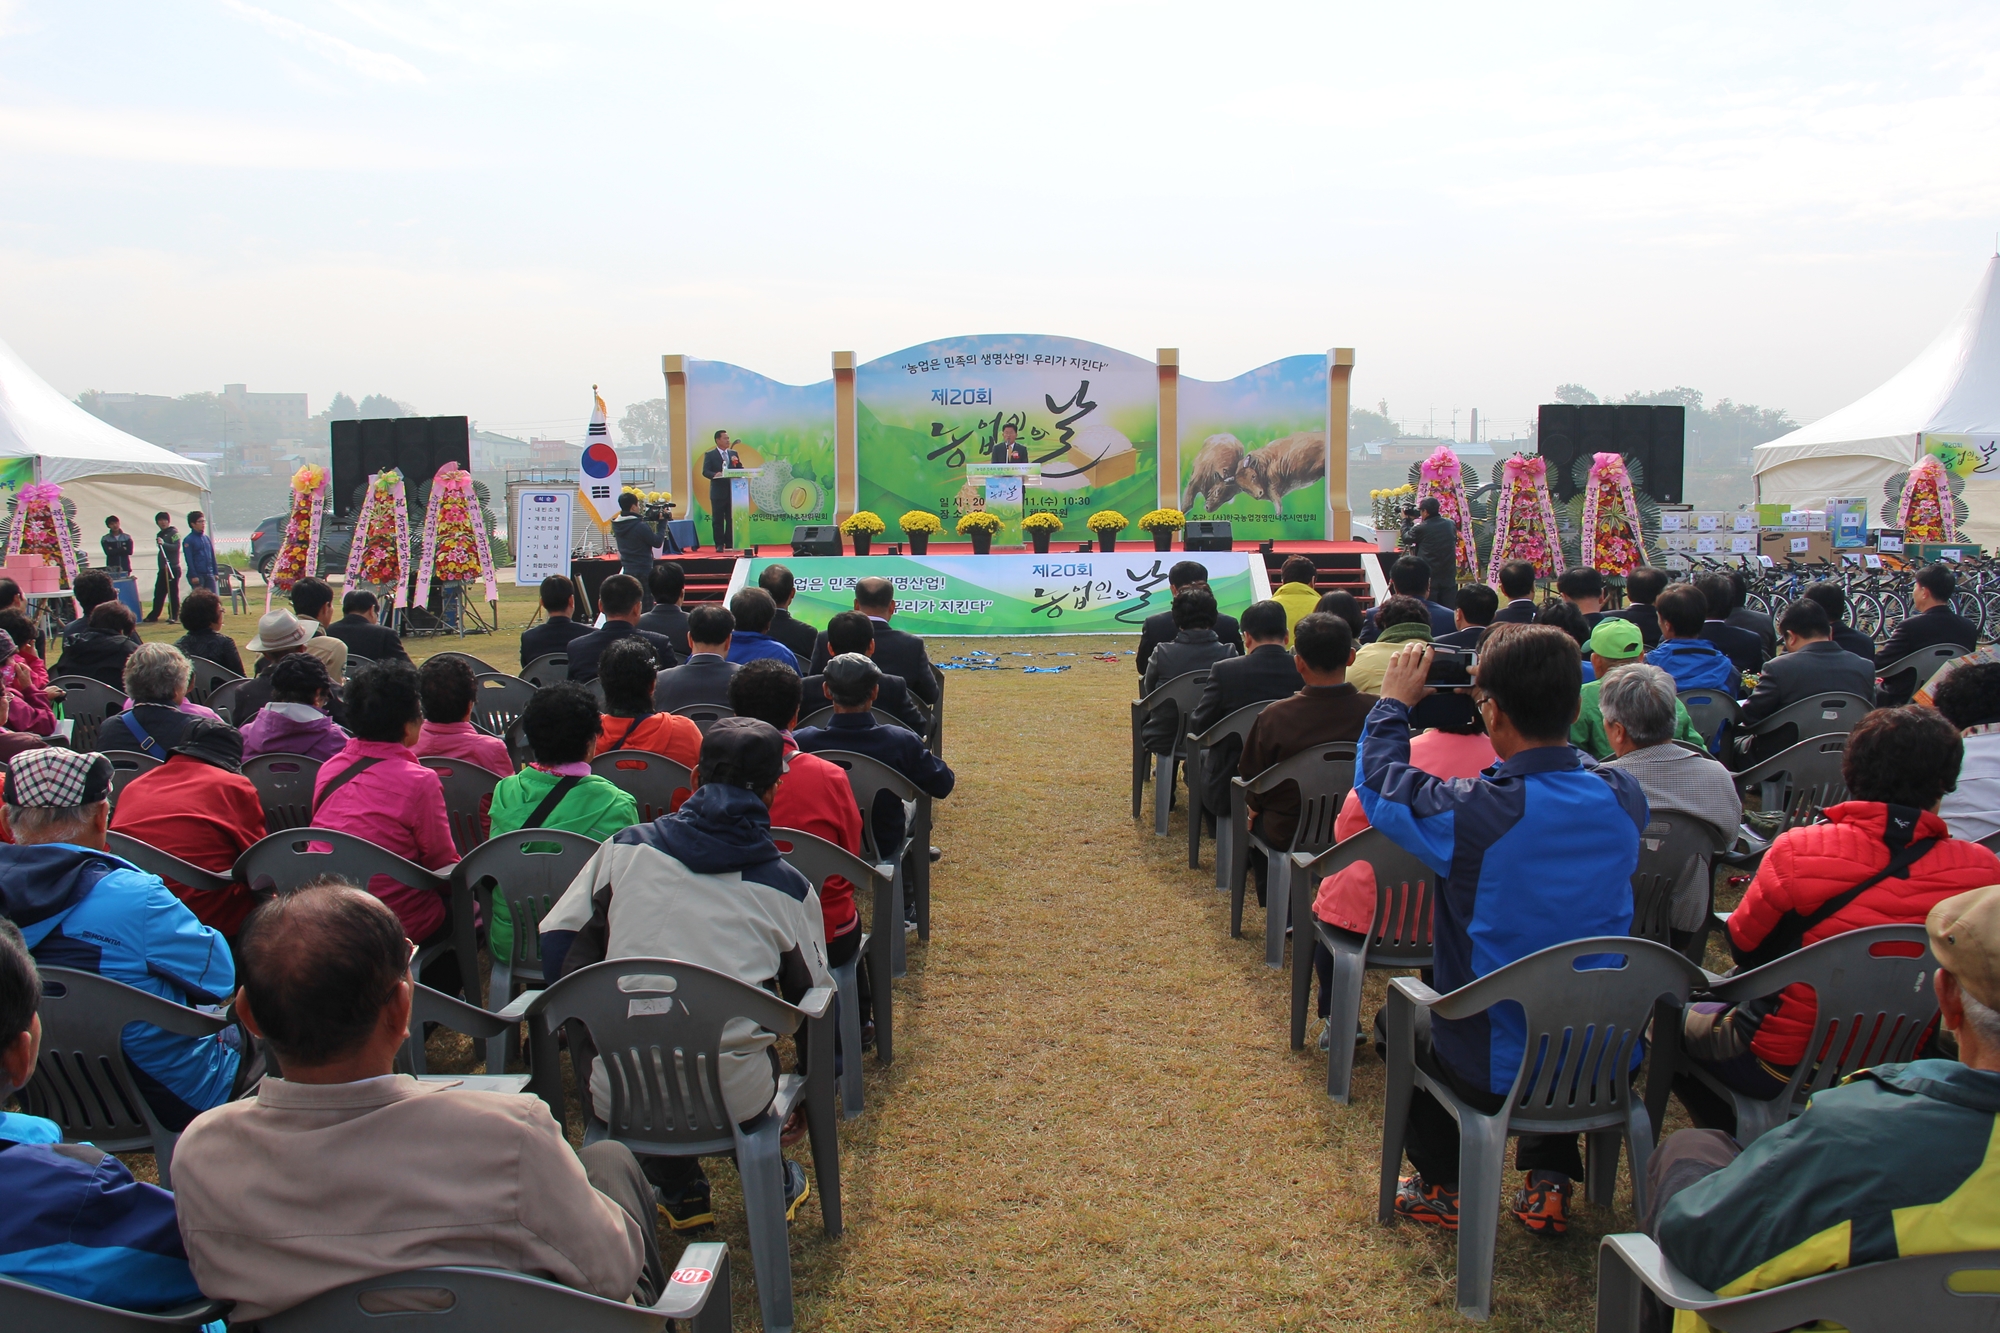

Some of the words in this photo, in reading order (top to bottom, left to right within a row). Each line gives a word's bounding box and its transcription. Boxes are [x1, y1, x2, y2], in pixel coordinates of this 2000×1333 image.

[944, 355, 976, 369] 민족의
[981, 353, 1029, 366] 생명산업!
[1033, 354, 1067, 367] 우리가
[931, 388, 992, 405] 제20회
[1030, 380, 1111, 478] 날
[1063, 497, 1091, 506] 10:30
[749, 512, 828, 522] 업인의날행사추진위원회
[1032, 563, 1093, 577] 제20회
[794, 577, 825, 592] 업은
[829, 577, 857, 591] 민족
[1031, 580, 1132, 618] 농업인의
[1114, 560, 1168, 624] 날
[676, 1269, 704, 1283] 101
